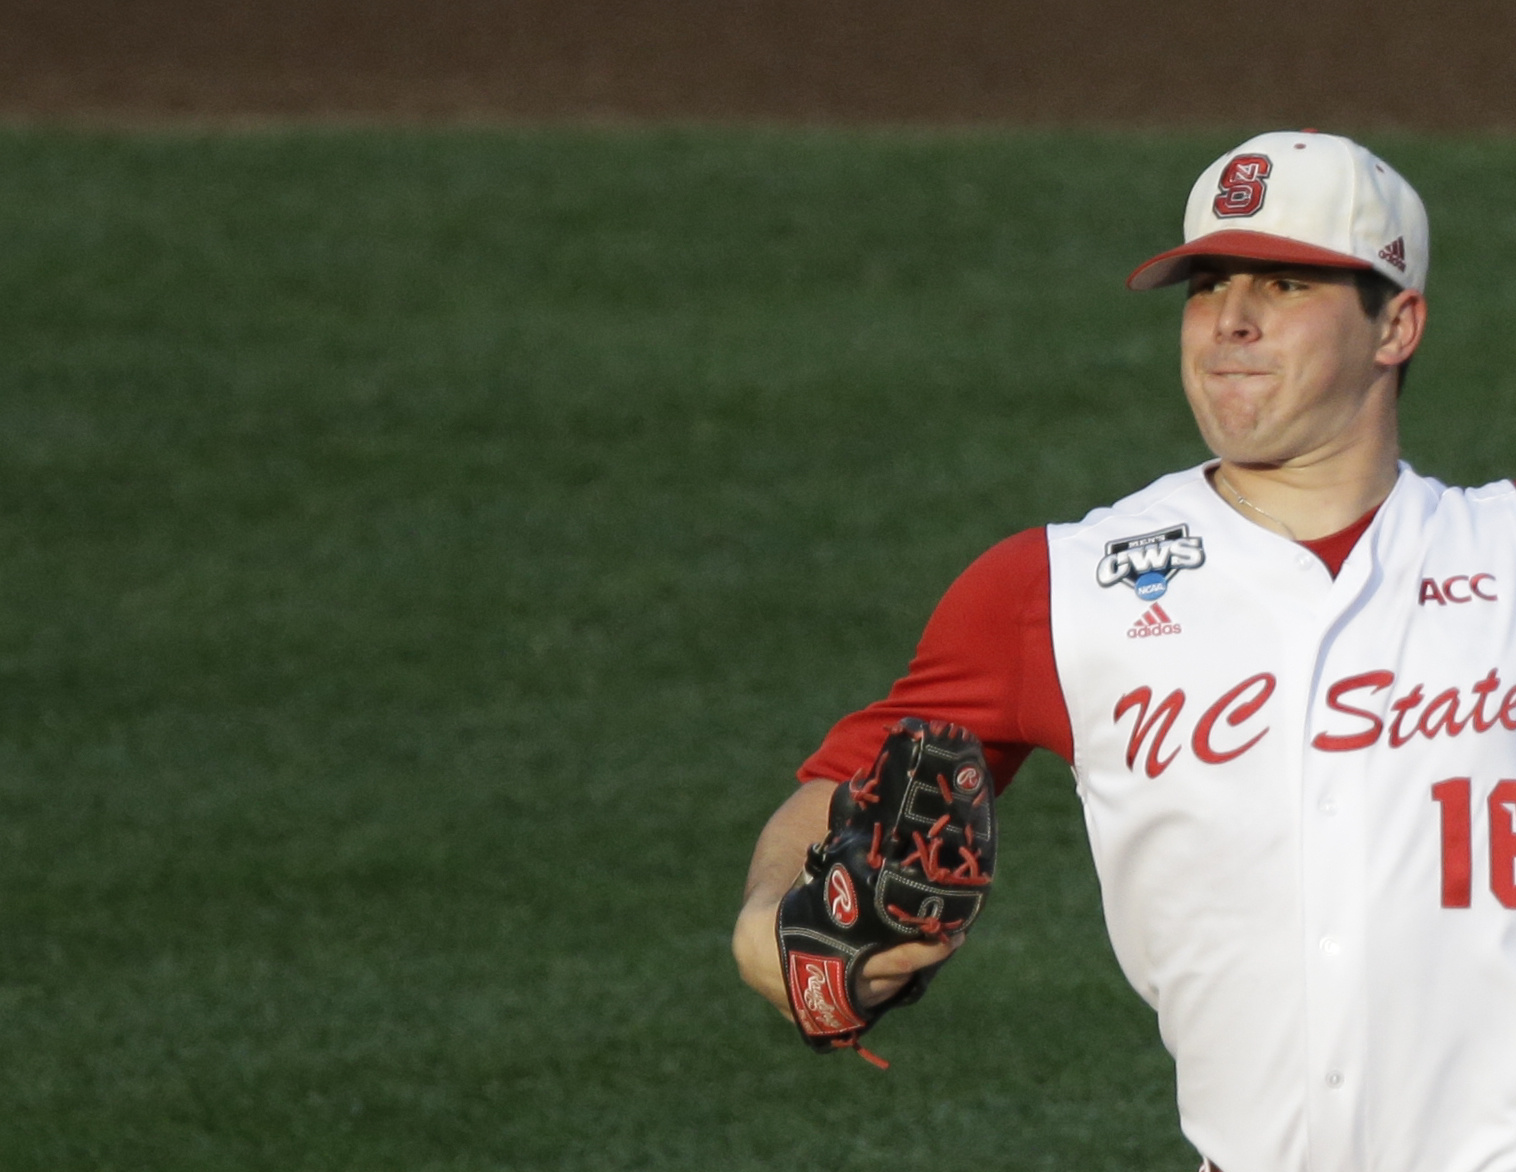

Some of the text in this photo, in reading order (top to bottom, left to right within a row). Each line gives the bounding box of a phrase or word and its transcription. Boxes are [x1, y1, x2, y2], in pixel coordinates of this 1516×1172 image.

[1096, 537, 1206, 588] CWS
[1138, 583, 1166, 595] NCAA
[1418, 573, 1498, 606] ACC
[1127, 623, 1182, 639] adidas
